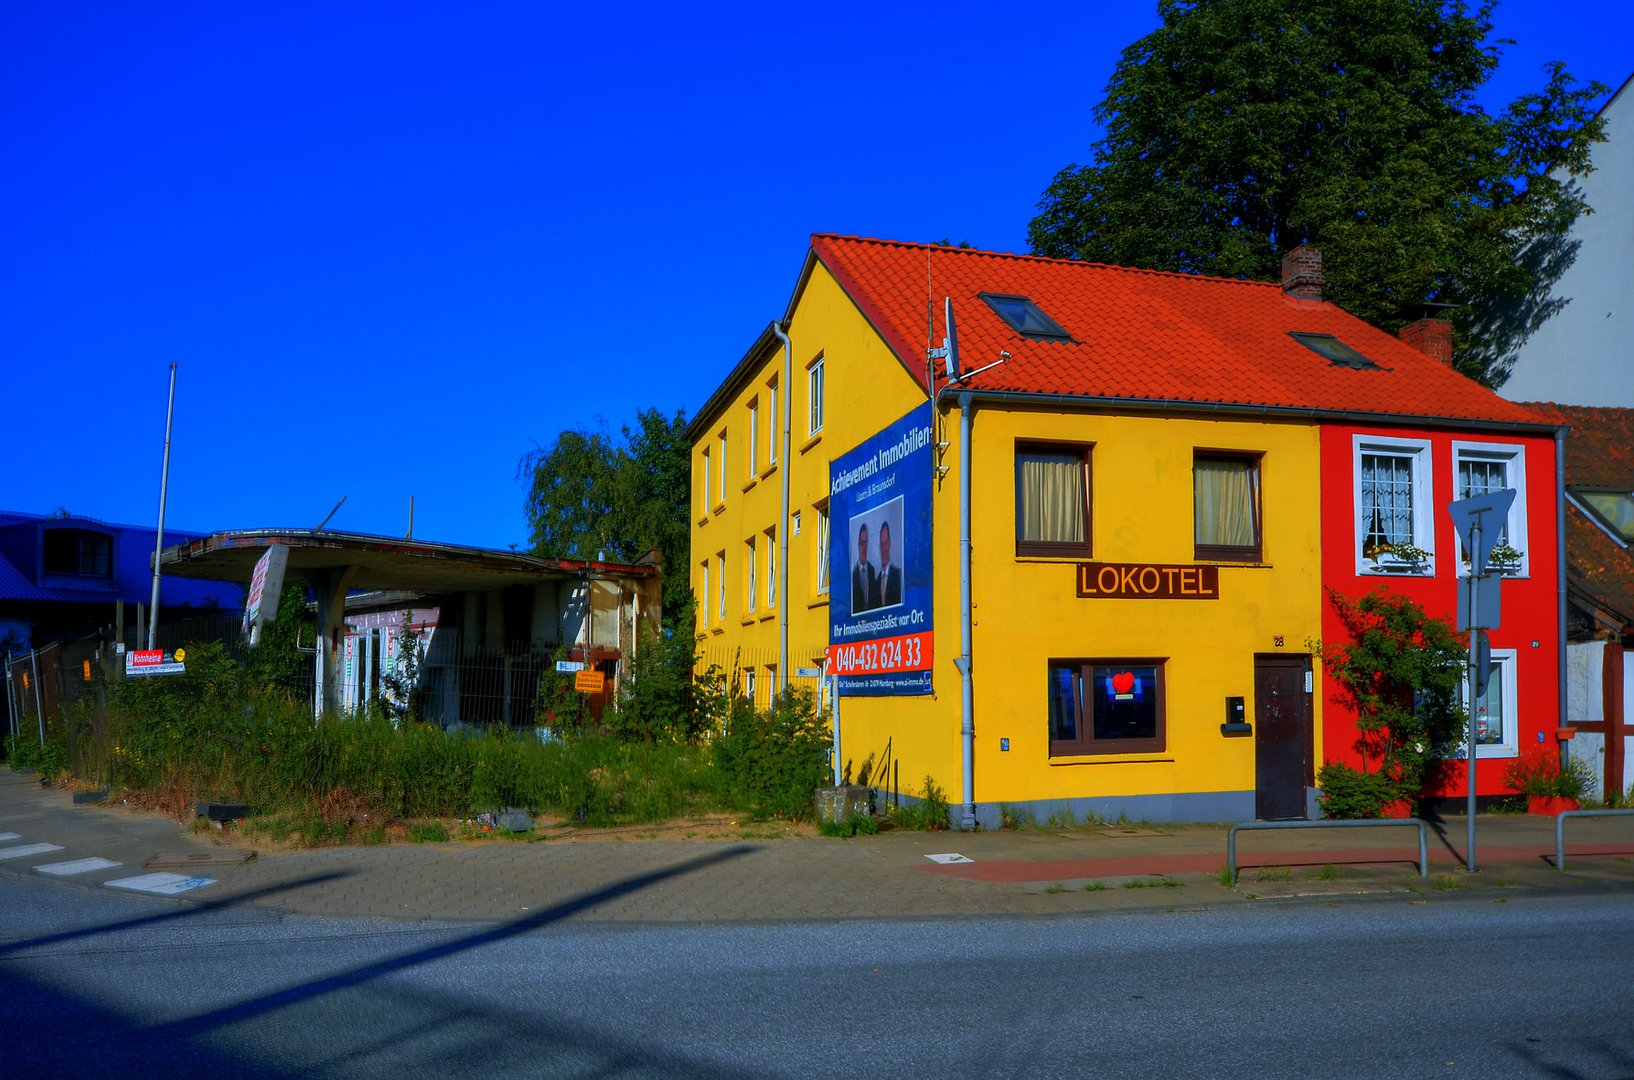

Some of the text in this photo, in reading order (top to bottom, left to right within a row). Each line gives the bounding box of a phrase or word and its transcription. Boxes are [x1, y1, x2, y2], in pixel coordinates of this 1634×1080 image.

[831, 455, 878, 496] Achievement
[1082, 566, 1213, 594] LOKOTEL
[834, 609, 924, 637] Ihr Immobilienspezialist vor Ort
[836, 637, 921, 672] 040-432 624 33
[1274, 636, 1284, 647] 28
